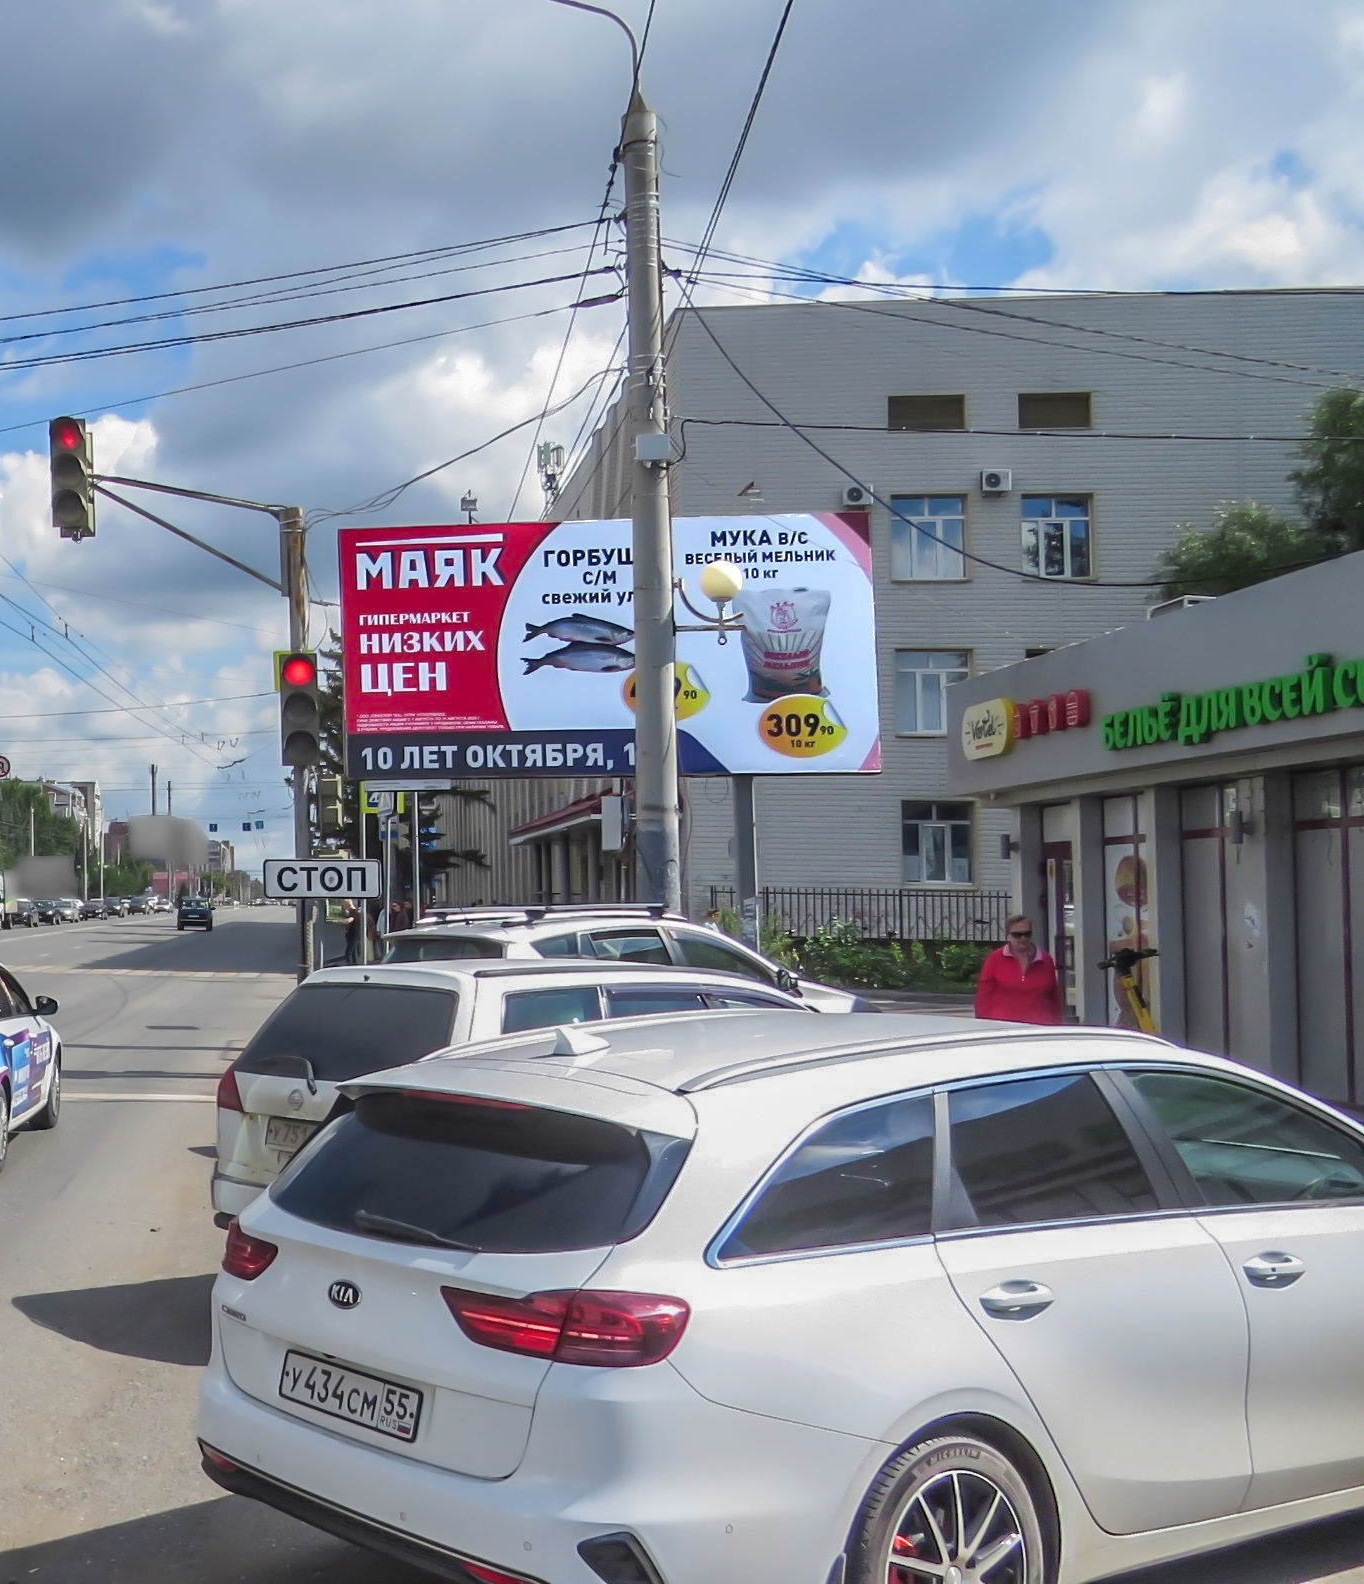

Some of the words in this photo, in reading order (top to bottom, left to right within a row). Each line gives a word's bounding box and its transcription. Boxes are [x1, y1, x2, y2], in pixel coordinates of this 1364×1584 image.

[710, 530, 772, 547] МУКА
[685, 549, 757, 565] ВЕСЕЛЫЙ
[762, 549, 836, 563] МЕЛЬНИК
[355, 547, 505, 591] МАЯК
[582, 570, 617, 586] С/М
[743, 567, 759, 579] 10
[763, 569, 778, 579] кг
[541, 588, 611, 604] свежий
[359, 611, 471, 626] ГИПЕРМАРКЕТ
[359, 630, 486, 654] НИЗКИХ
[360, 661, 447, 697] ЦЕН
[683, 689, 698, 700] 90
[1101, 692, 1178, 751] БЕЛЬЁ
[1178, 686, 1238, 746] ДЛЯ
[1239, 653, 1333, 726] ВСЕЙ
[767, 713, 820, 737] 309
[820, 725, 834, 735] 90
[790, 739, 801, 748] 10
[361, 747, 393, 770] 10
[400, 745, 458, 769] ЛЕТ
[465, 742, 614, 771] ОКТЯБРЯ,
[276, 866, 367, 892] СТОП
[330, 1283, 354, 1304] KIA
[289, 1365, 378, 1422] У434СМ
[383, 1388, 410, 1420] 55
[379, 1415, 398, 1430] RUS
